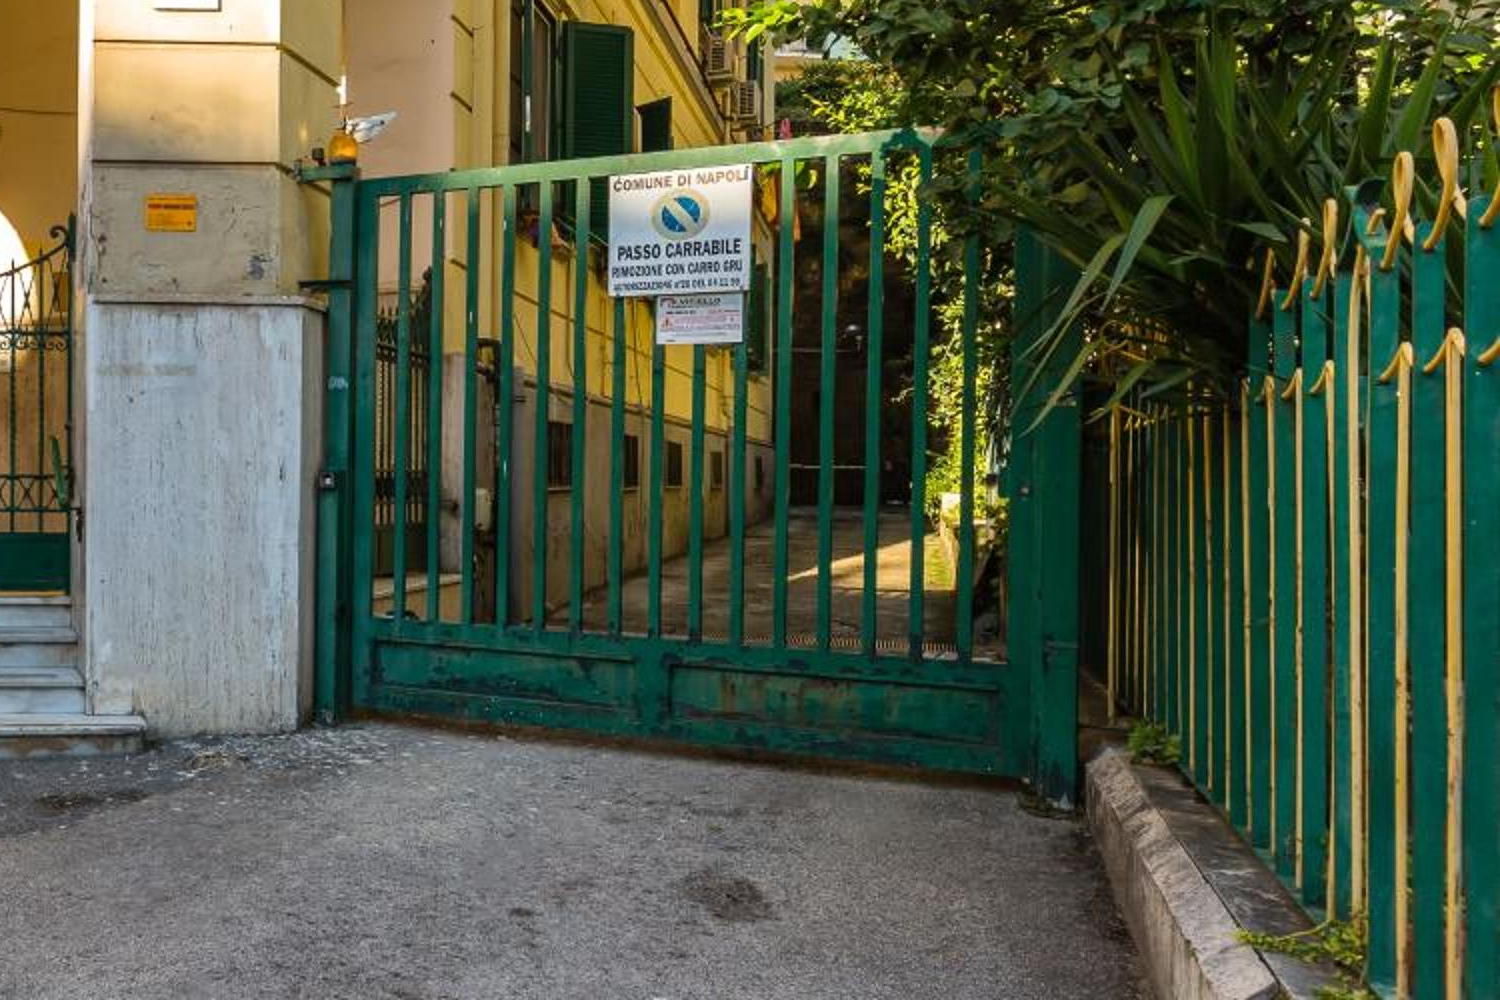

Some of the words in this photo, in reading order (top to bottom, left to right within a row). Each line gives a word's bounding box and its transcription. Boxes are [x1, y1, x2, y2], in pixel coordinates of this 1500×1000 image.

[613, 175, 673, 193] COMUNE
[677, 174, 691, 187] DI
[697, 167, 749, 185] NAPOLI
[617, 243, 661, 261] PASSO
[665, 238, 742, 259] CARRABILE
[612, 263, 663, 279] RIMOZIONE
[665, 263, 685, 276] CON
[687, 261, 721, 275] CARRO
[723, 259, 743, 273] GRU
